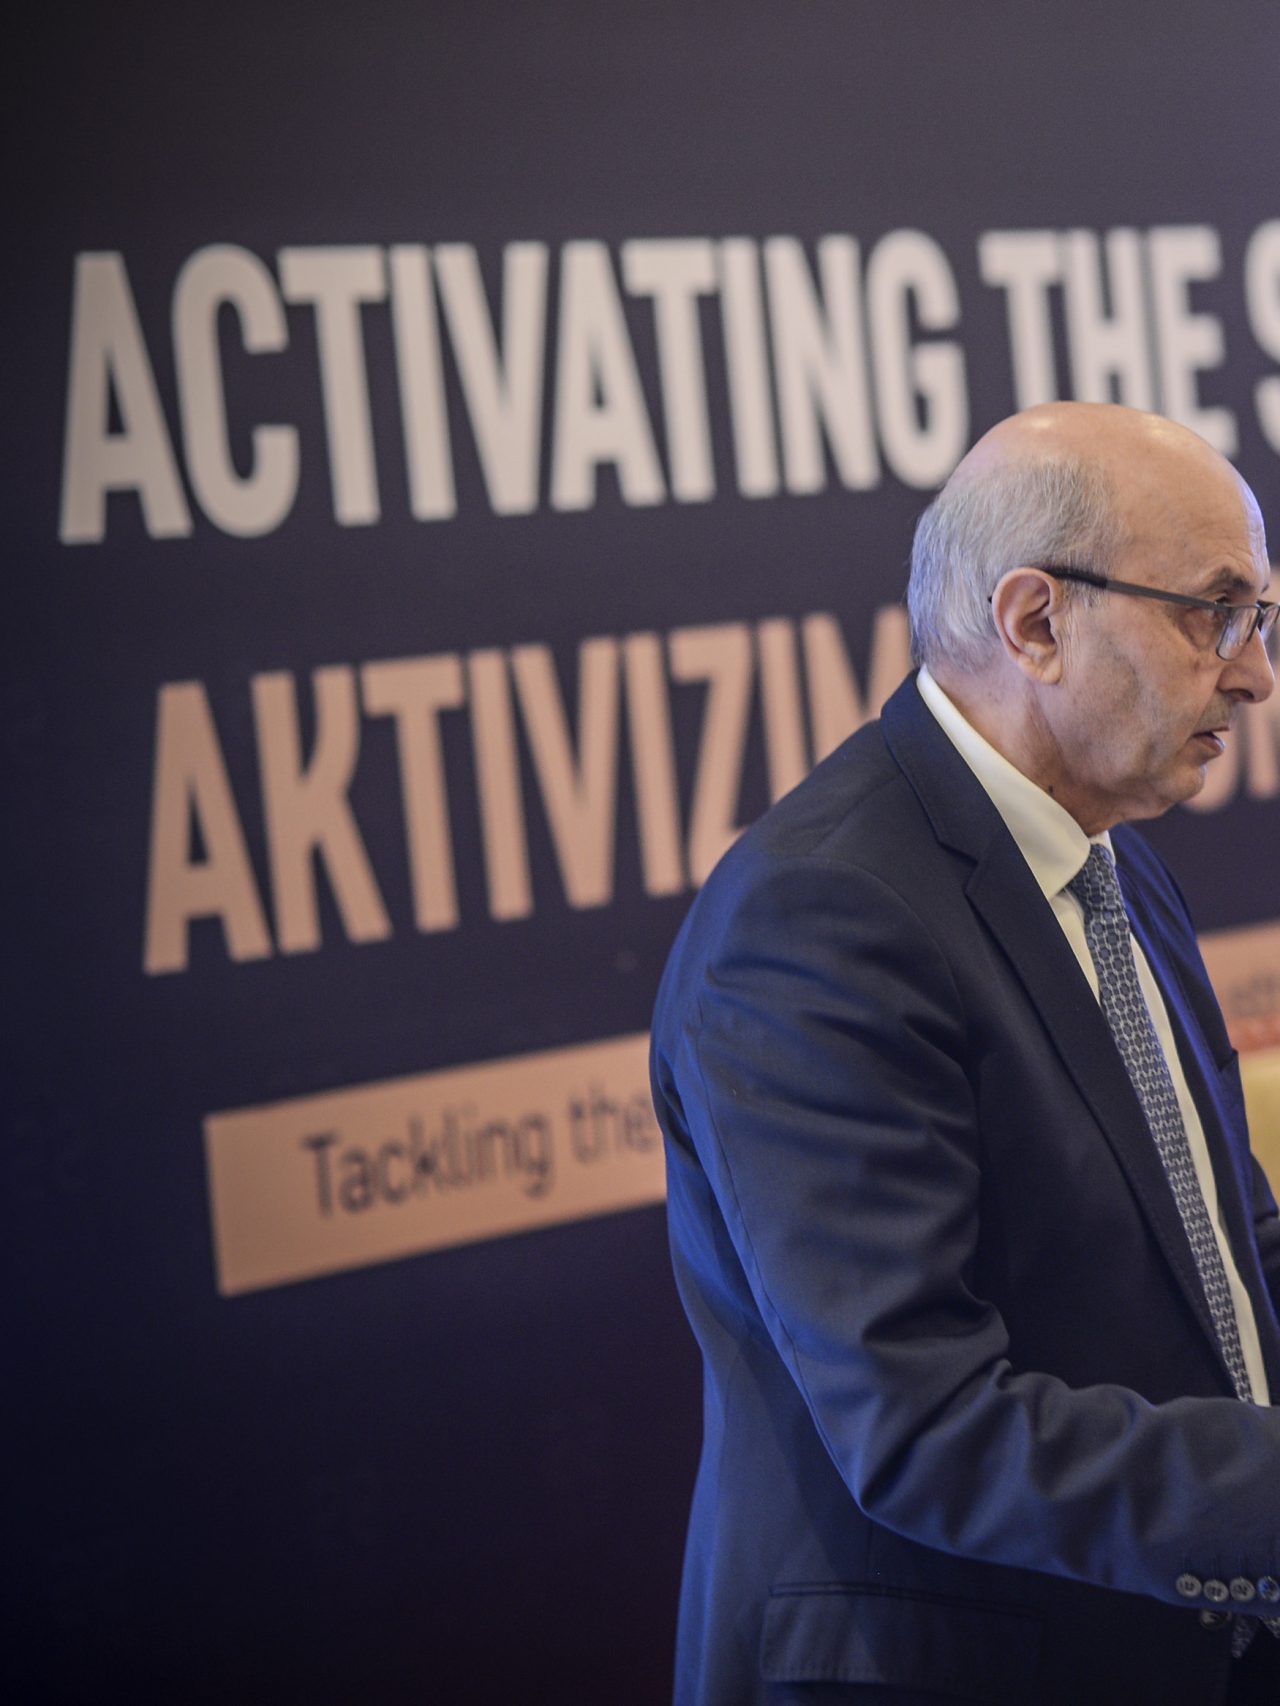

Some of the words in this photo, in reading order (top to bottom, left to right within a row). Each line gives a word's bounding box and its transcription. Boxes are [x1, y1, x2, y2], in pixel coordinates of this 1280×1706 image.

[59, 227, 969, 545] ACTIVATING
[977, 224, 1238, 459] THE
[301, 1103, 557, 1220] Tackling
[567, 1078, 660, 1165] the
